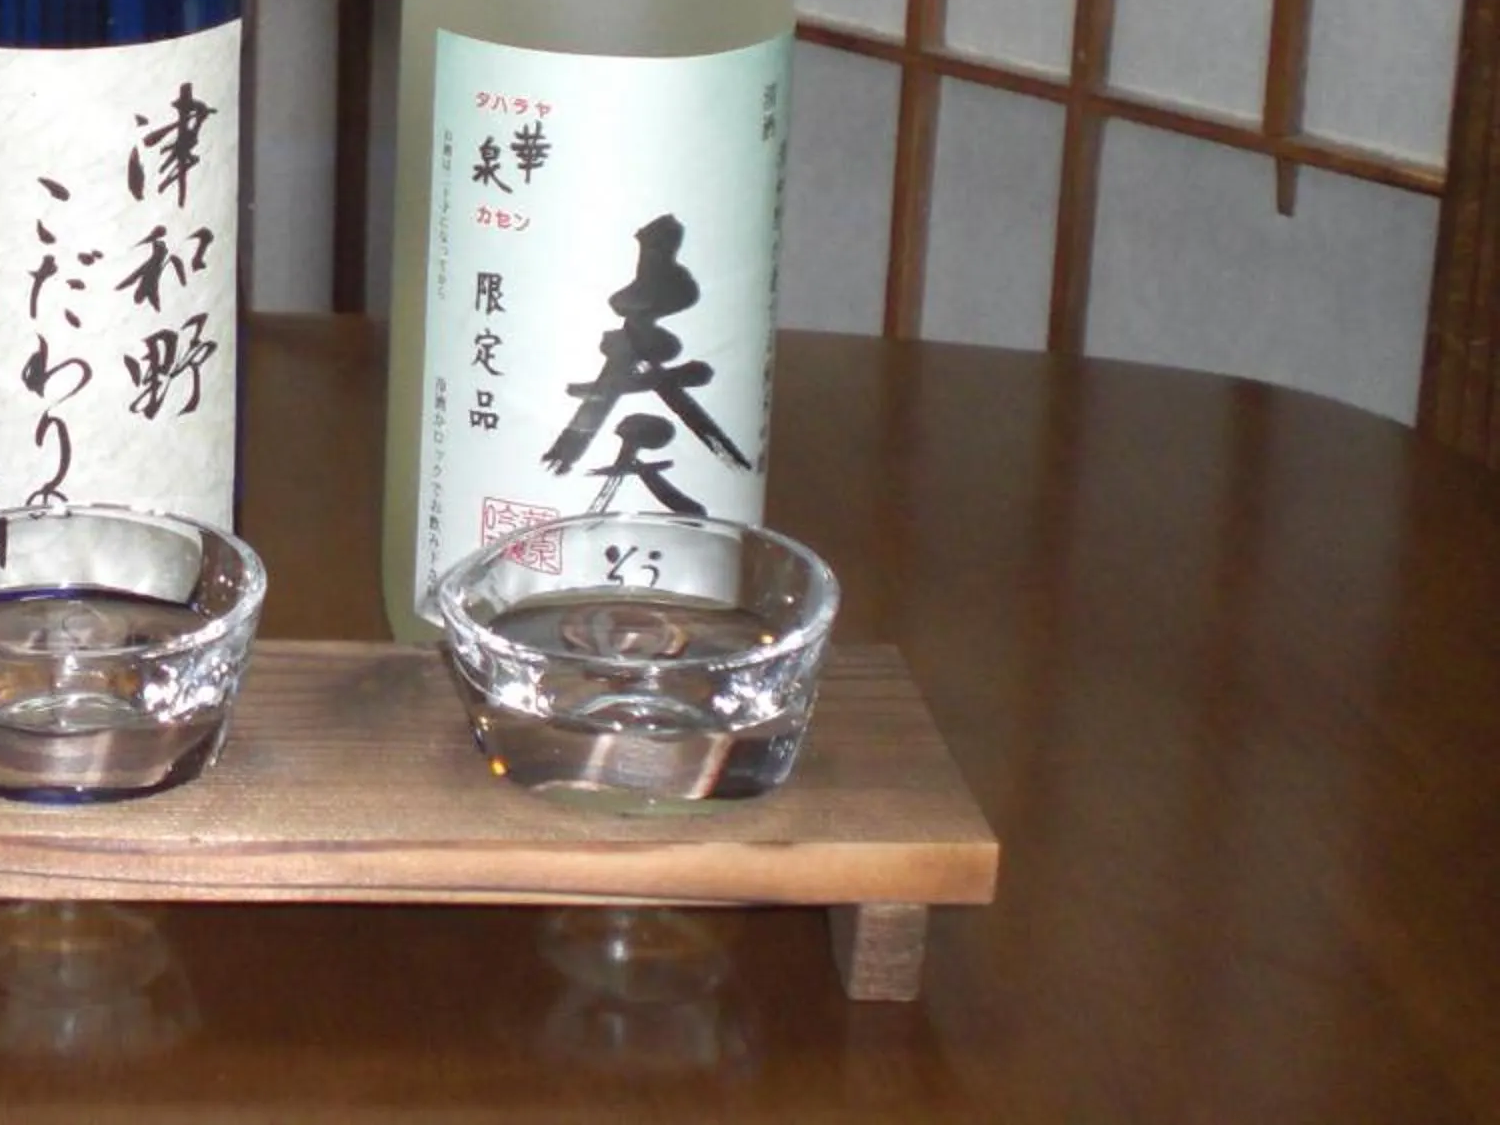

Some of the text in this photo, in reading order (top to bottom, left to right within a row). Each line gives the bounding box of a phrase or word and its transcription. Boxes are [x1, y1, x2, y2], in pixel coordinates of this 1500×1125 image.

[475, 91, 552, 118] タハラヤ
[116, 83, 218, 421] 津和野
[476, 206, 530, 231] カセン
[469, 271, 506, 430] 限定品
